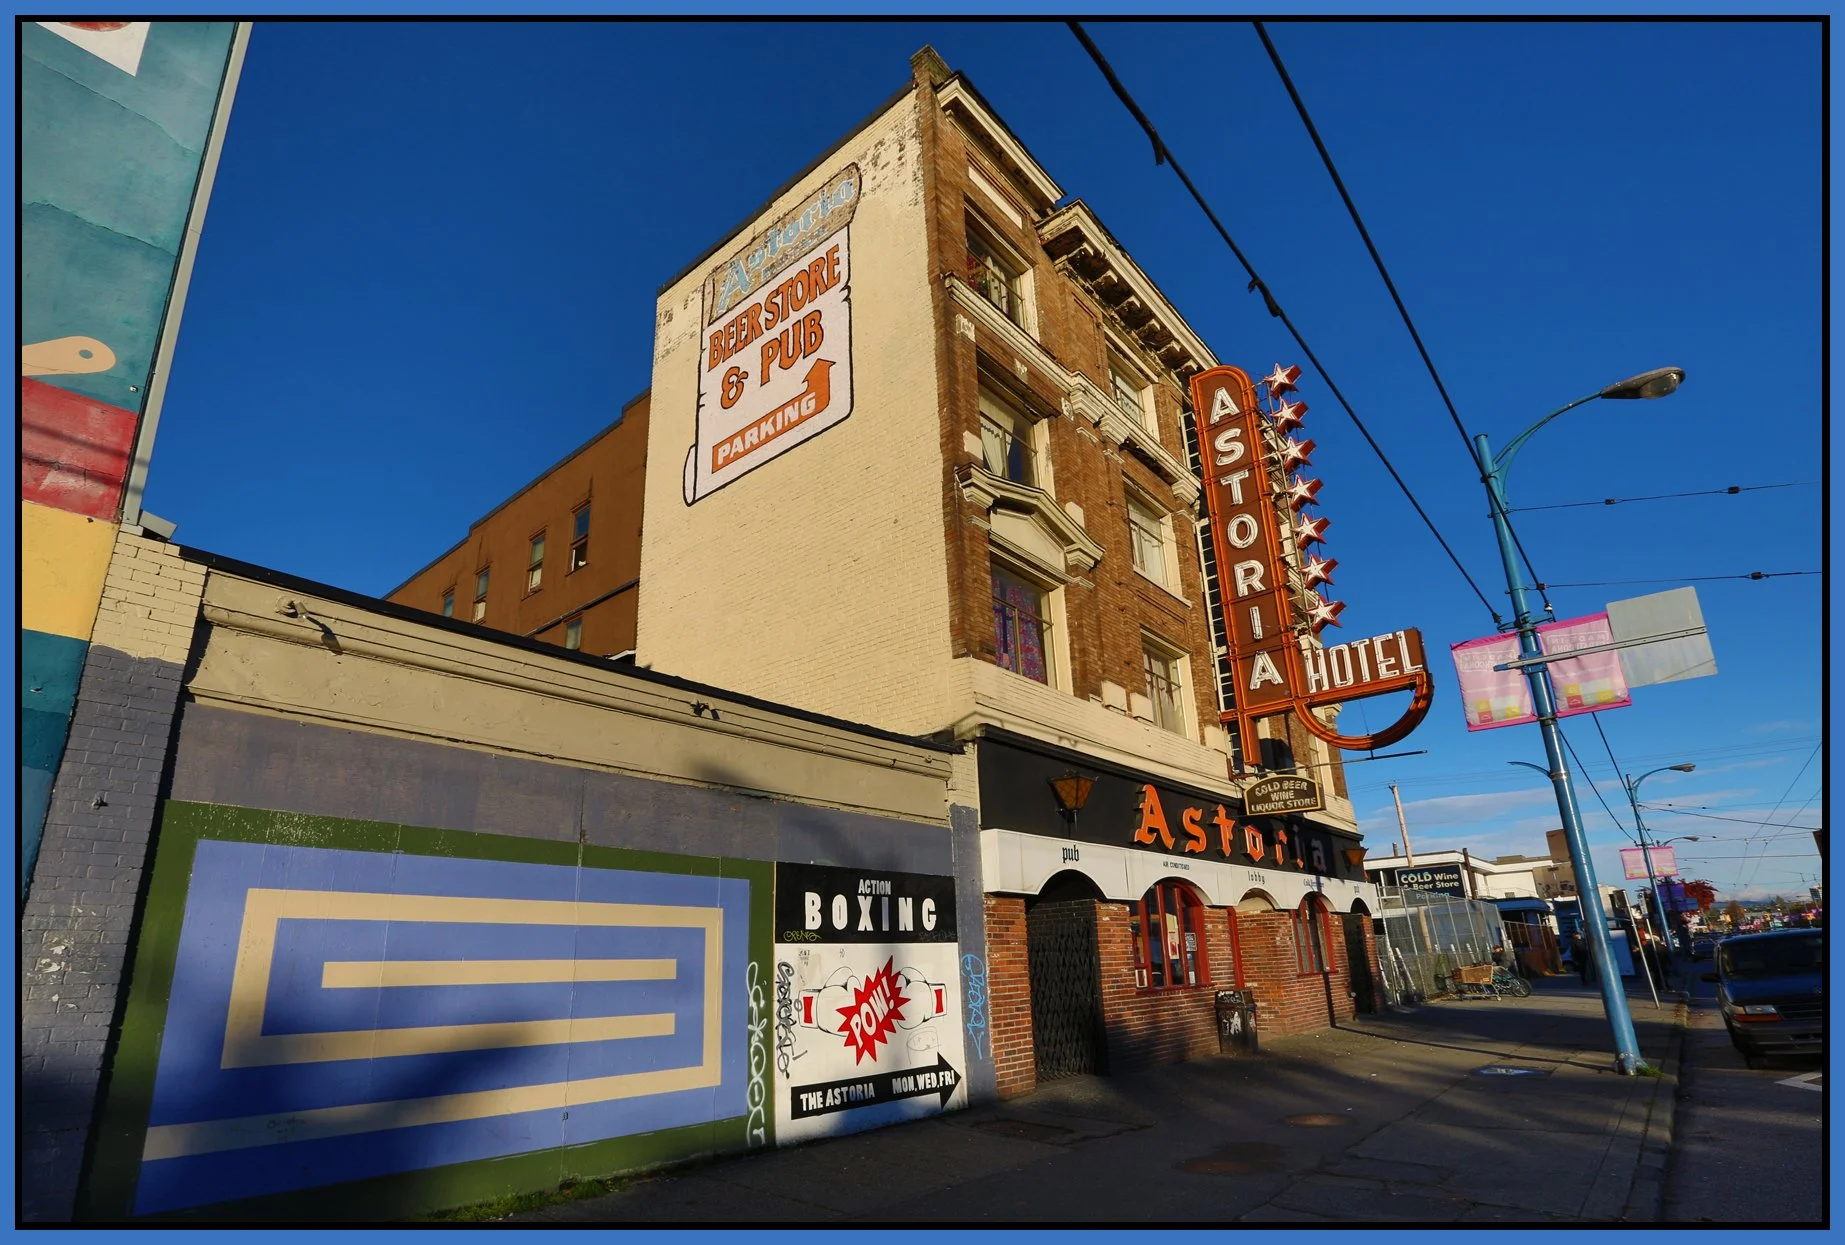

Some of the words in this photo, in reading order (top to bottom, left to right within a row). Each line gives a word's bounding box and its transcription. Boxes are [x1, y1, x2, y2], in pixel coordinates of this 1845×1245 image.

[708, 302, 764, 372] BEER
[764, 244, 841, 332] STORE
[720, 366, 749, 410] &
[760, 310, 824, 387] PUB
[717, 392, 816, 466] PARKING
[1209, 386, 1284, 690] ASTORIA
[1304, 630, 1424, 694] HOTEL
[1251, 801, 1285, 812] LIQUOR
[1286, 797, 1317, 808] STORE
[1255, 781, 1280, 796] COLD
[1282, 780, 1308, 790] BEER
[1271, 790, 1295, 801] WINE
[1134, 784, 1327, 873] Astoria
[1062, 844, 1079, 864] pub
[858, 879, 891, 895] ACTION
[1248, 870, 1265, 885] lobby
[1401, 872, 1432, 883] COLD
[1433, 873, 1459, 881] Wine
[804, 892, 937, 931] BOXING
[850, 977, 895, 1045] POW!
[800, 1091, 824, 1112] THE
[825, 1082, 876, 1107] ASTORIA
